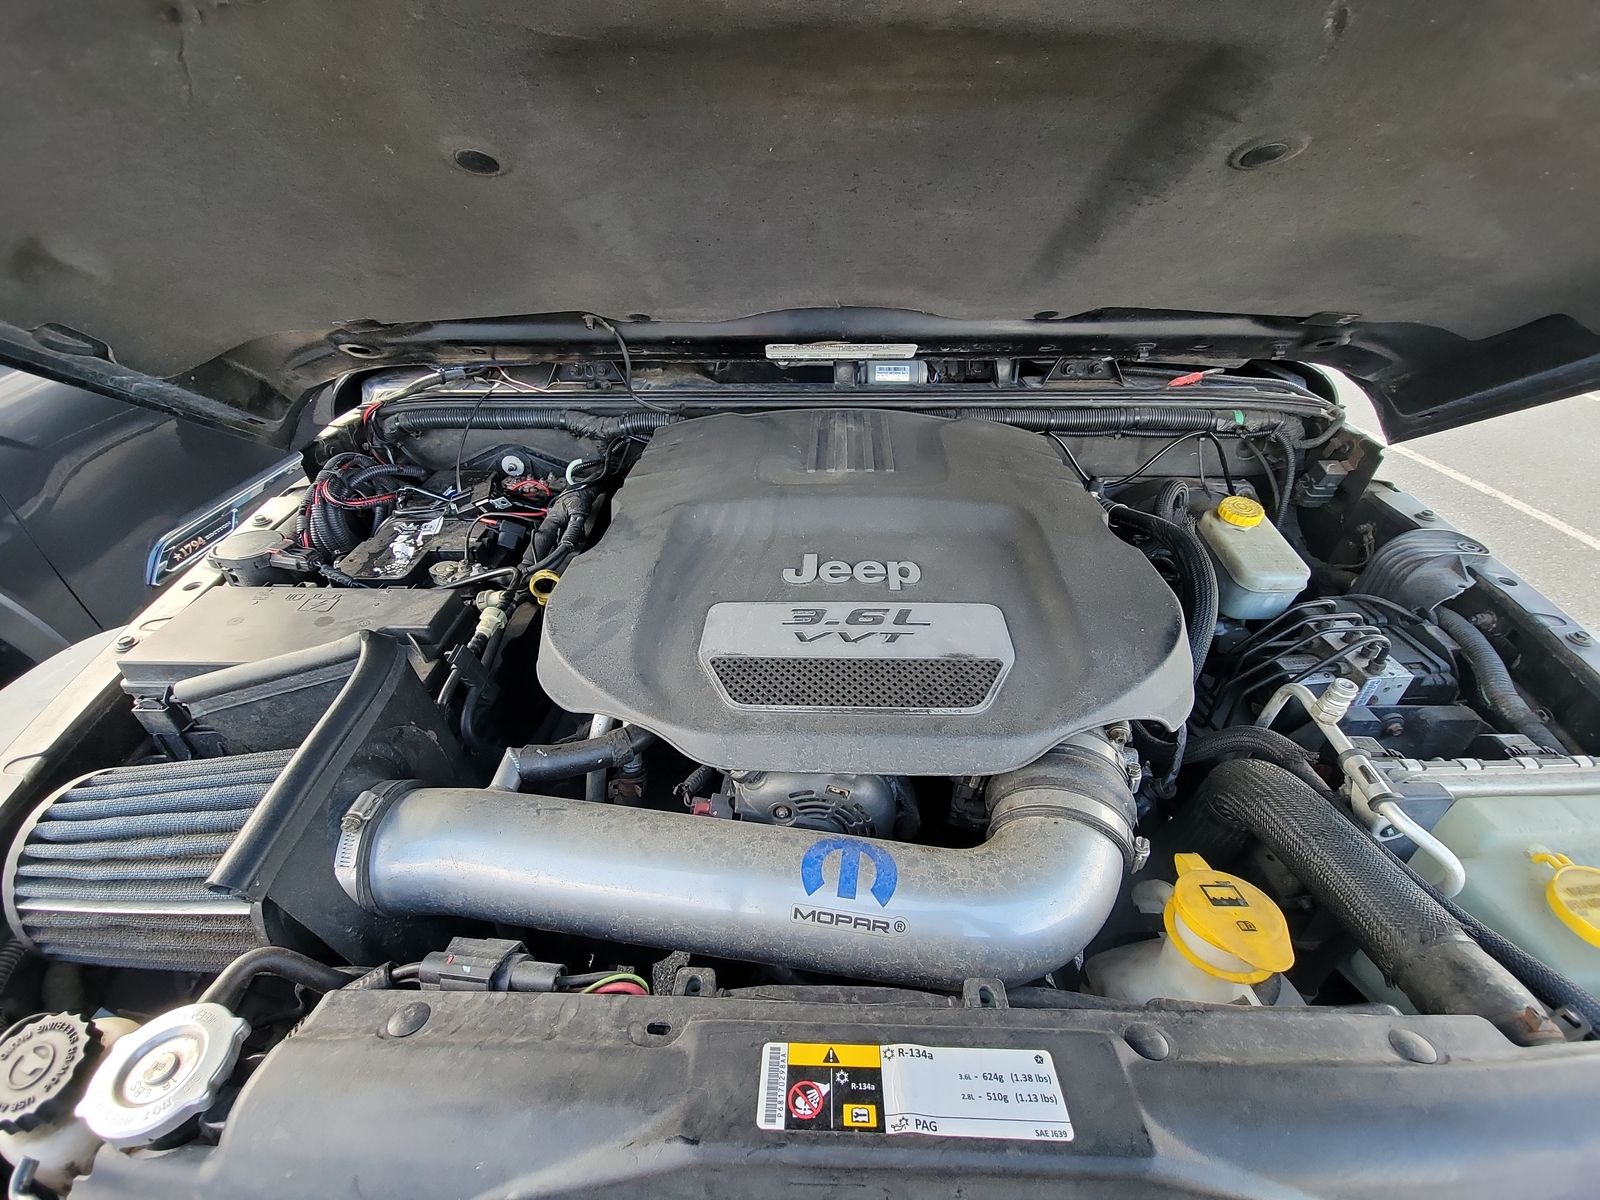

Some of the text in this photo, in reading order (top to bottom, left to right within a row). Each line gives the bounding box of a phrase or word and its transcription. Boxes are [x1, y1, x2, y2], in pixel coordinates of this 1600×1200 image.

[179, 536, 206, 557] 1794
[781, 553, 922, 591] Jeep
[781, 608, 932, 626] 3.6L
[793, 631, 915, 644] VVT
[898, 1048, 934, 1060] R-134a
[958, 1073, 973, 1081] 3.6L
[982, 1072, 1005, 1084] 624g
[1010, 1072, 1034, 1083] (1.38
[1035, 1073, 1052, 1085] lbs)
[776, 1053, 787, 1118] P68170298AA
[851, 1082, 876, 1091] R-134a
[961, 1093, 976, 1101] 2.8L
[986, 1092, 1010, 1104] 510g
[1015, 1093, 1039, 1104] (1.13
[1040, 1093, 1058, 1105] lbs)
[915, 1118, 938, 1132] PAG
[1035, 1129, 1068, 1138] SAE J639
